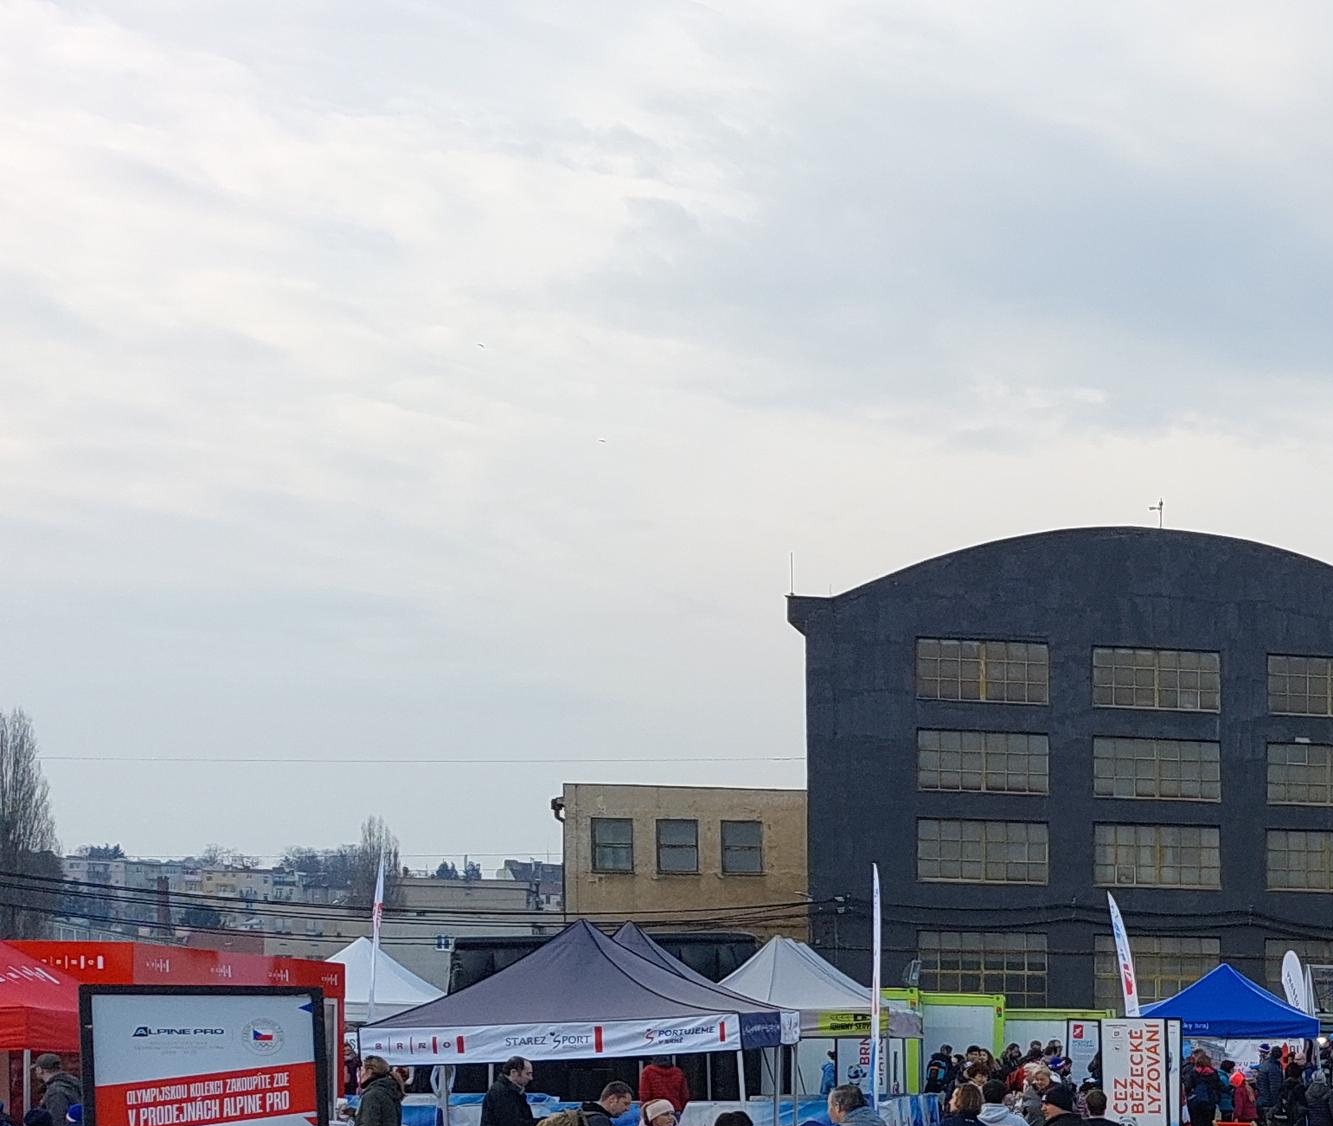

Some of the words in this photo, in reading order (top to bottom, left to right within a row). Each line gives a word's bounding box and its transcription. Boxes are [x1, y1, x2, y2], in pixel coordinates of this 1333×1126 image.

[132, 1026, 191, 1037] ALPINE
[193, 1027, 224, 1036] PRO
[505, 1036, 546, 1047] STAREZ
[860, 1037, 871, 1066] BRN
[1128, 1029, 1145, 1114] BĚŽECKÉ
[1144, 1022, 1161, 1114] LYŽOVÁNÍ
[126, 1084, 188, 1105] OLYMPIJSKOU
[190, 1079, 223, 1096] KOLEKCI
[225, 1072, 271, 1094] ZAKOUPÍTE
[273, 1072, 289, 1087] ZDE
[223, 1092, 263, 1117] ALPINE
[265, 1090, 290, 1113] PRO
